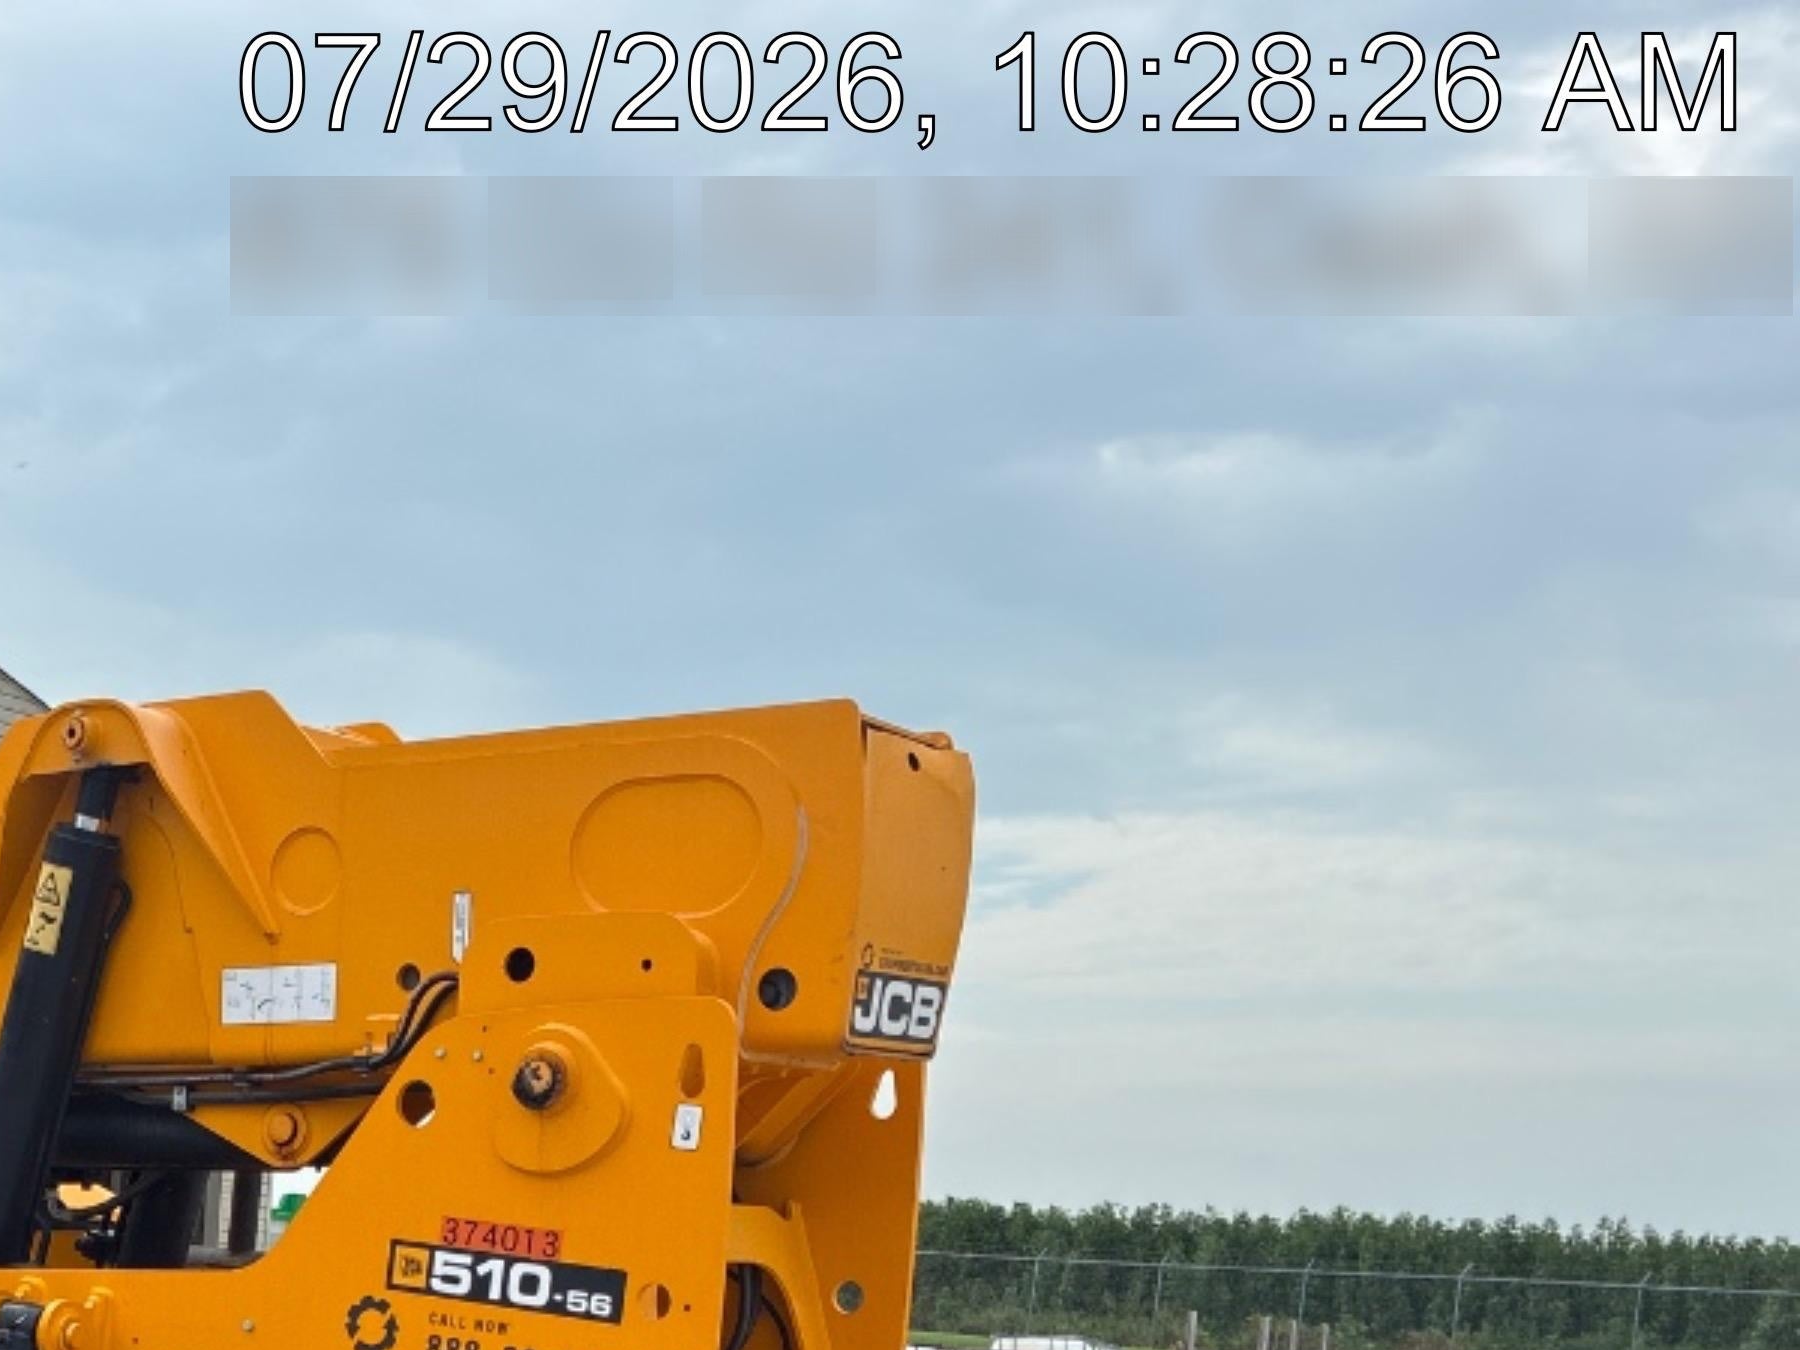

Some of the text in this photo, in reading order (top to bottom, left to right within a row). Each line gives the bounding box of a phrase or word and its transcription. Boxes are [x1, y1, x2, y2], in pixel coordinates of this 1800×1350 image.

[853, 976, 943, 1039] JCB
[442, 1217, 561, 1258] 374013
[428, 1312, 511, 1336] CALL NOW
